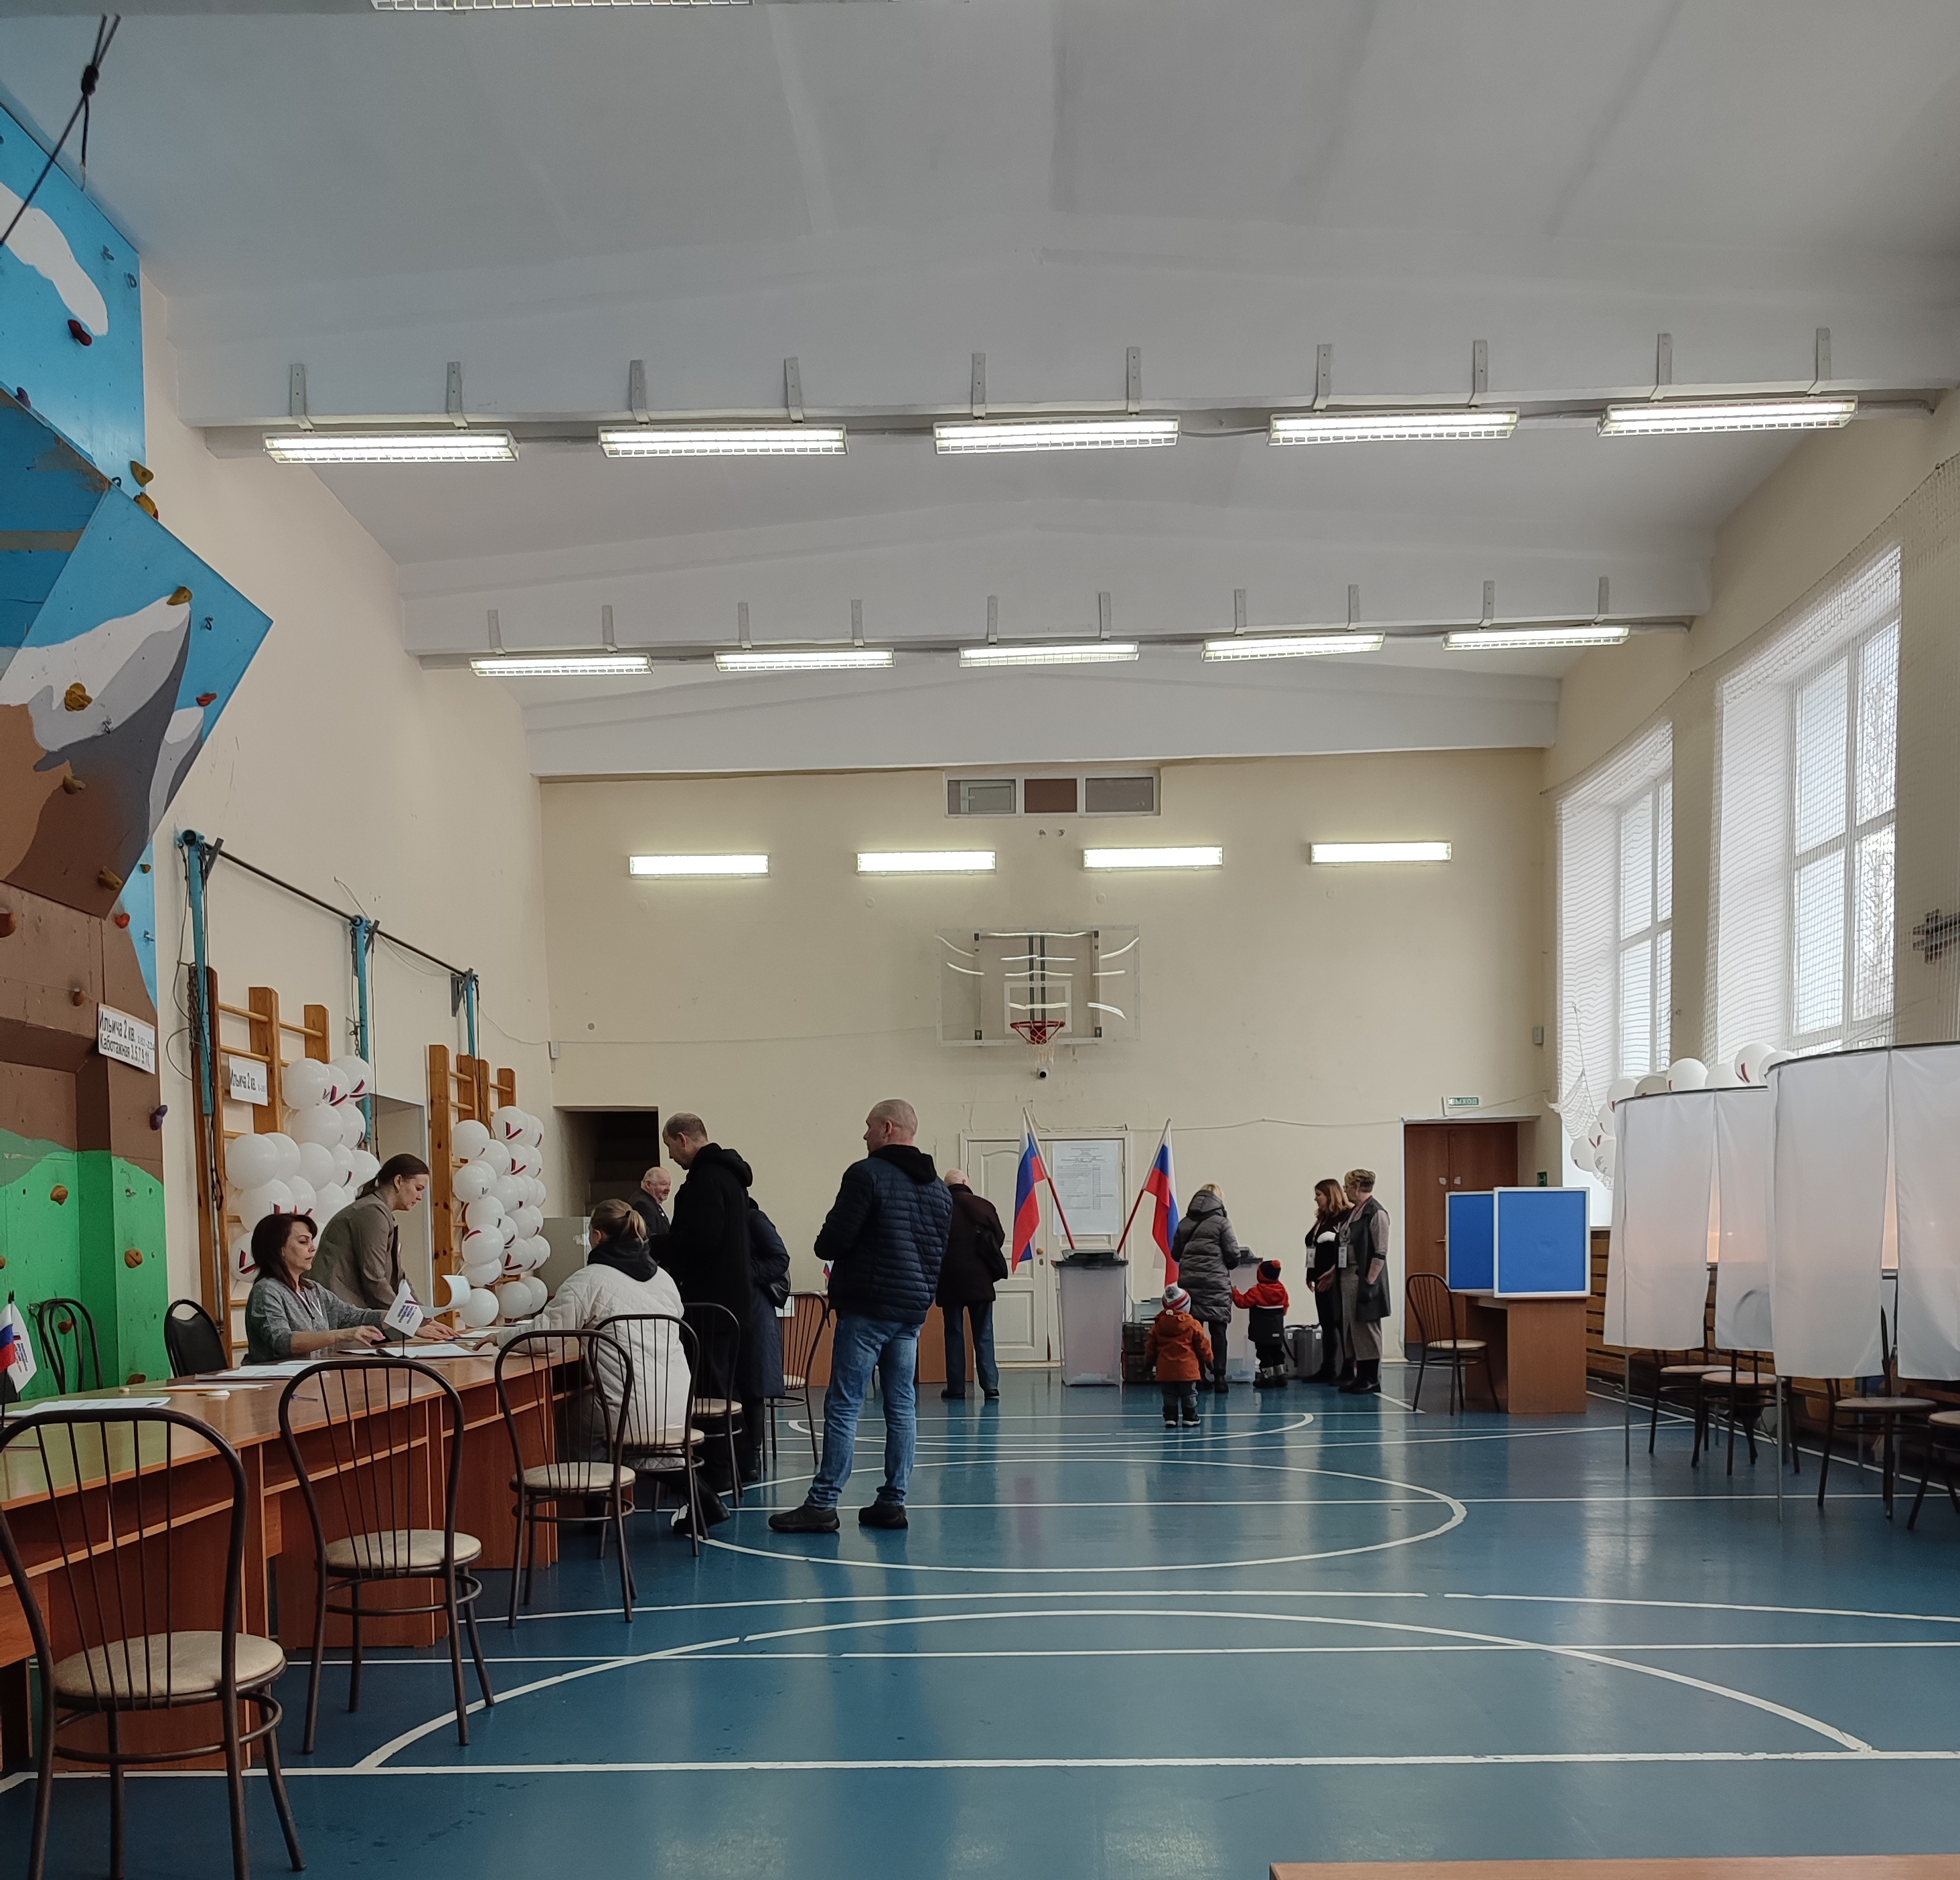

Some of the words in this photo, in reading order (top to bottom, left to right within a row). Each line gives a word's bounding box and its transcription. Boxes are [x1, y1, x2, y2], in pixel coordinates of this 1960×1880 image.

[99, 1010, 123, 1037] Ильича
[123, 1019, 127, 1039] 2
[128, 1026, 136, 1043] кв.
[100, 1033, 131, 1059] Каботажная
[246, 1072, 250, 1090] 2
